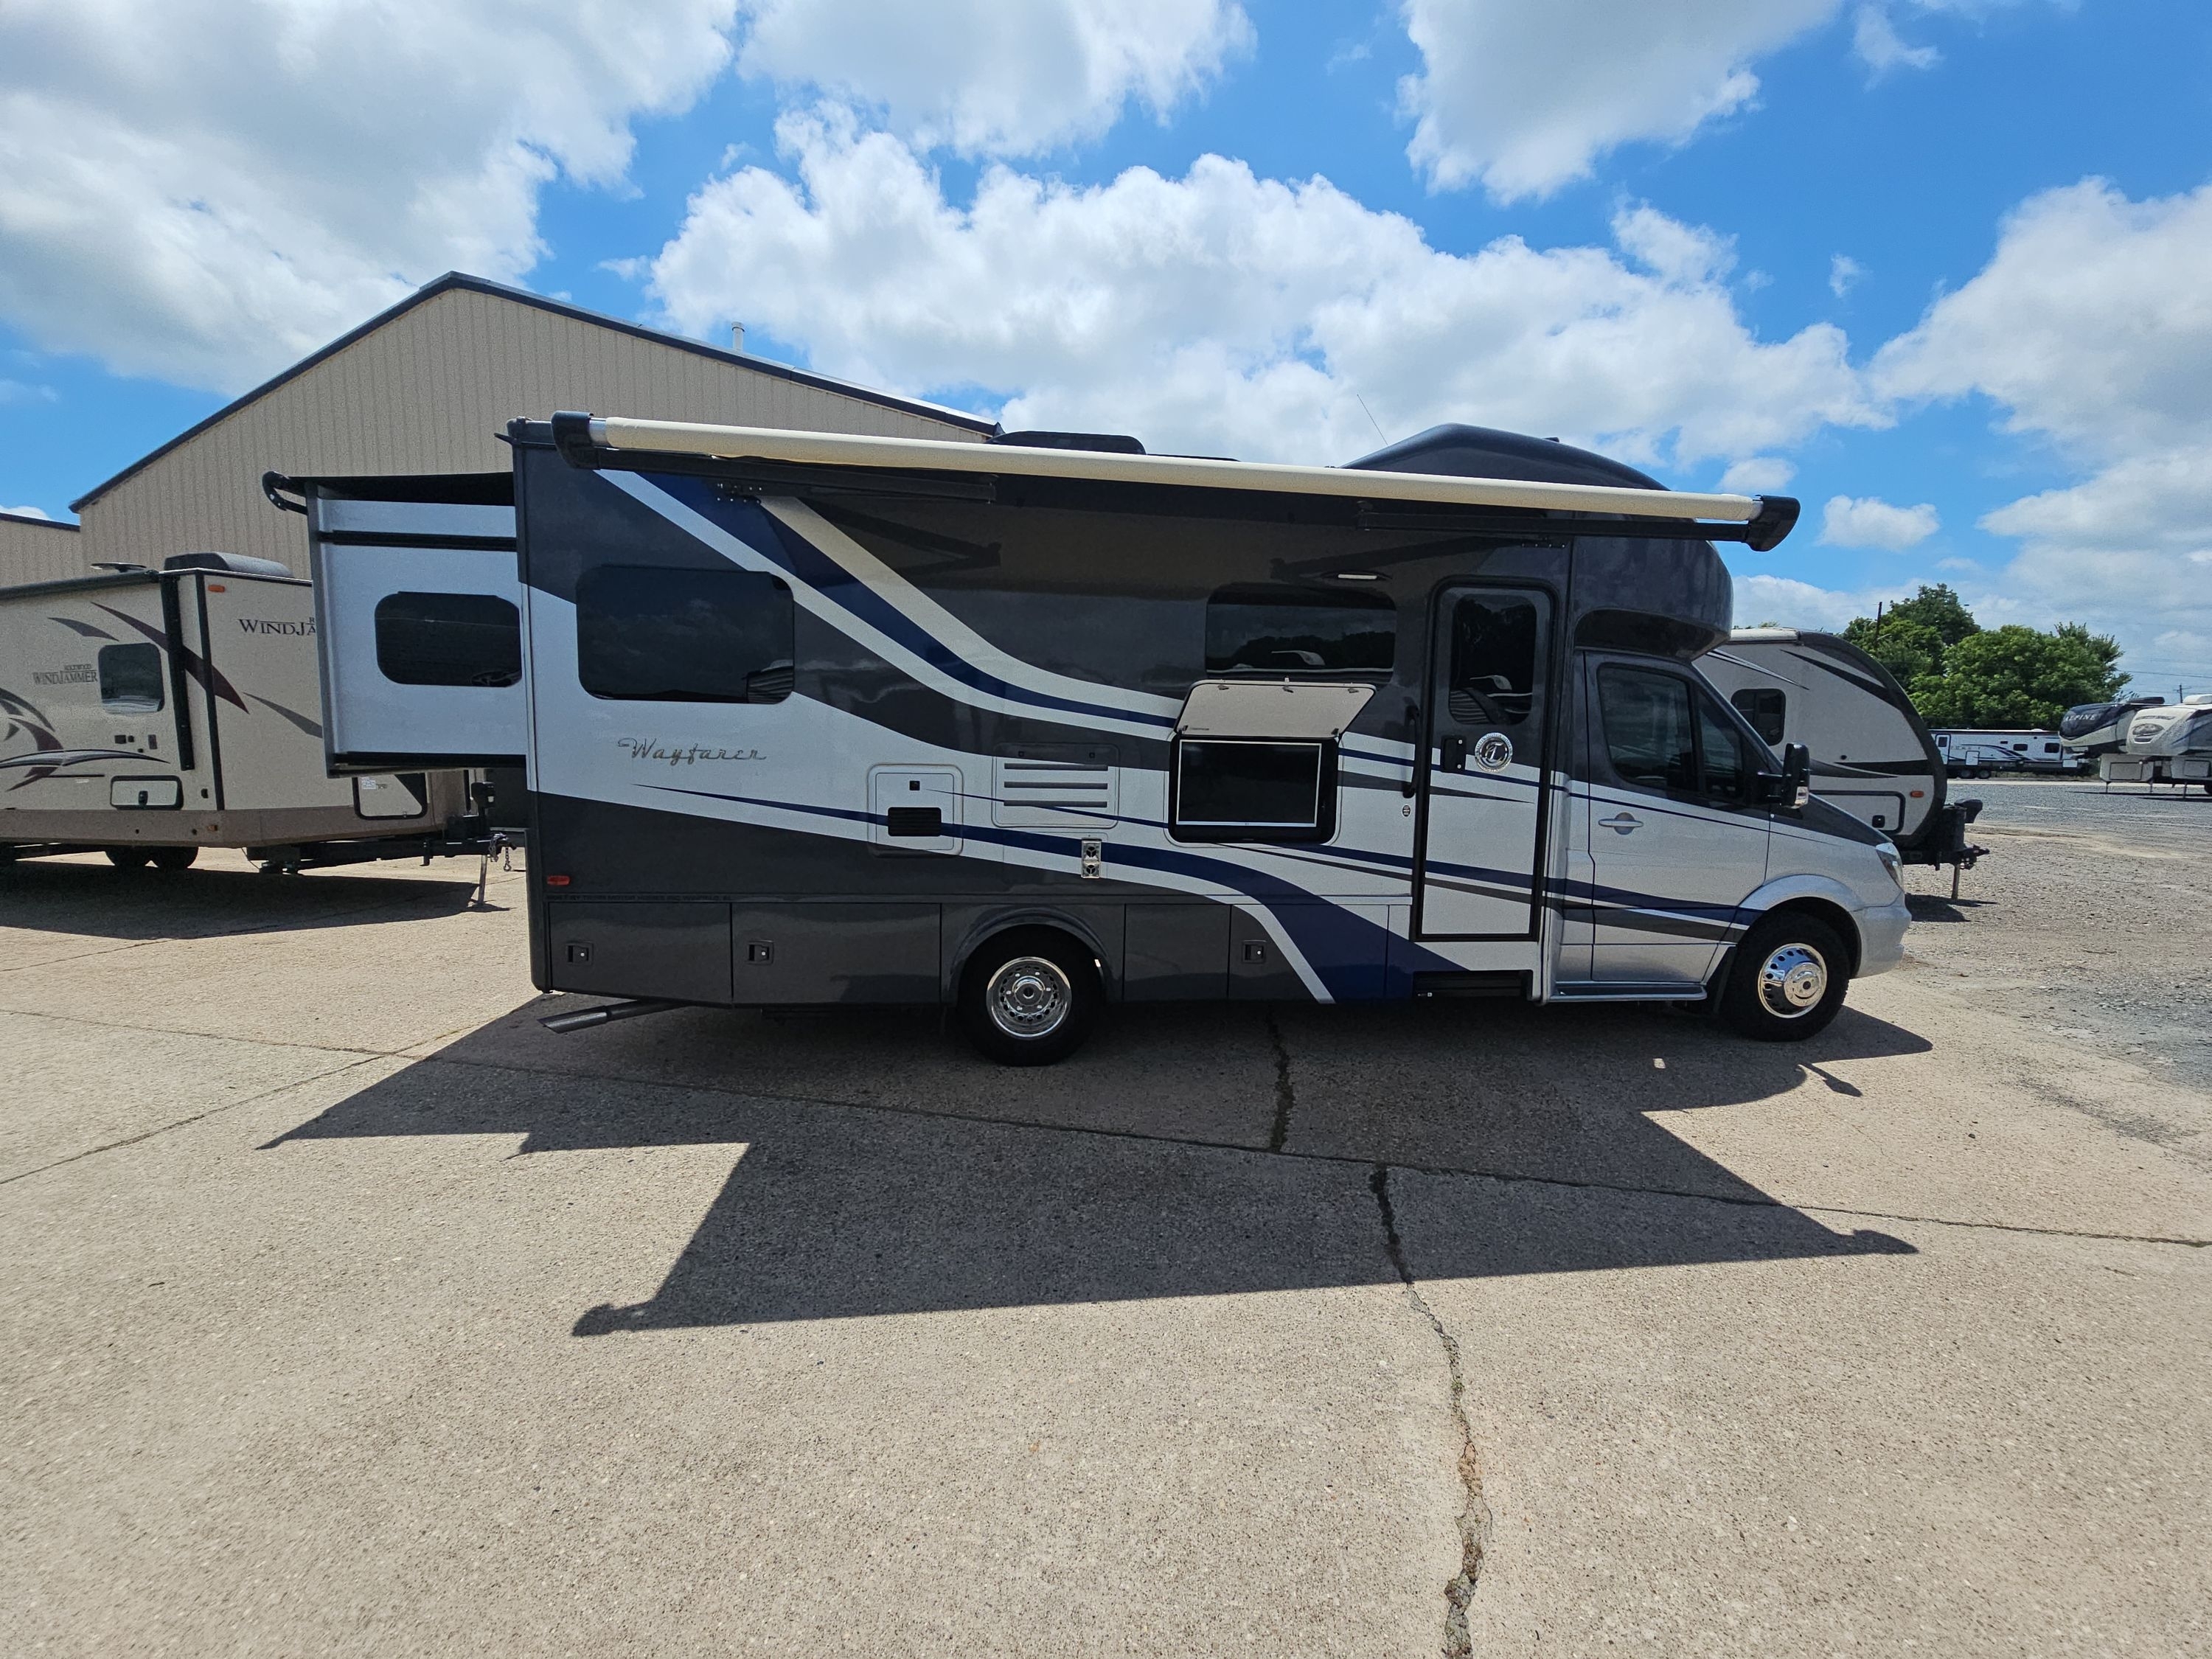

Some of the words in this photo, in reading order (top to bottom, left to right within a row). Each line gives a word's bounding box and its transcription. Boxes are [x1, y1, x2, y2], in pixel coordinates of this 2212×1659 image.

[32, 670, 98, 684] WINDJAMMER
[2065, 714, 2097, 722] ALPINE
[617, 738, 767, 766] Wayfarer
